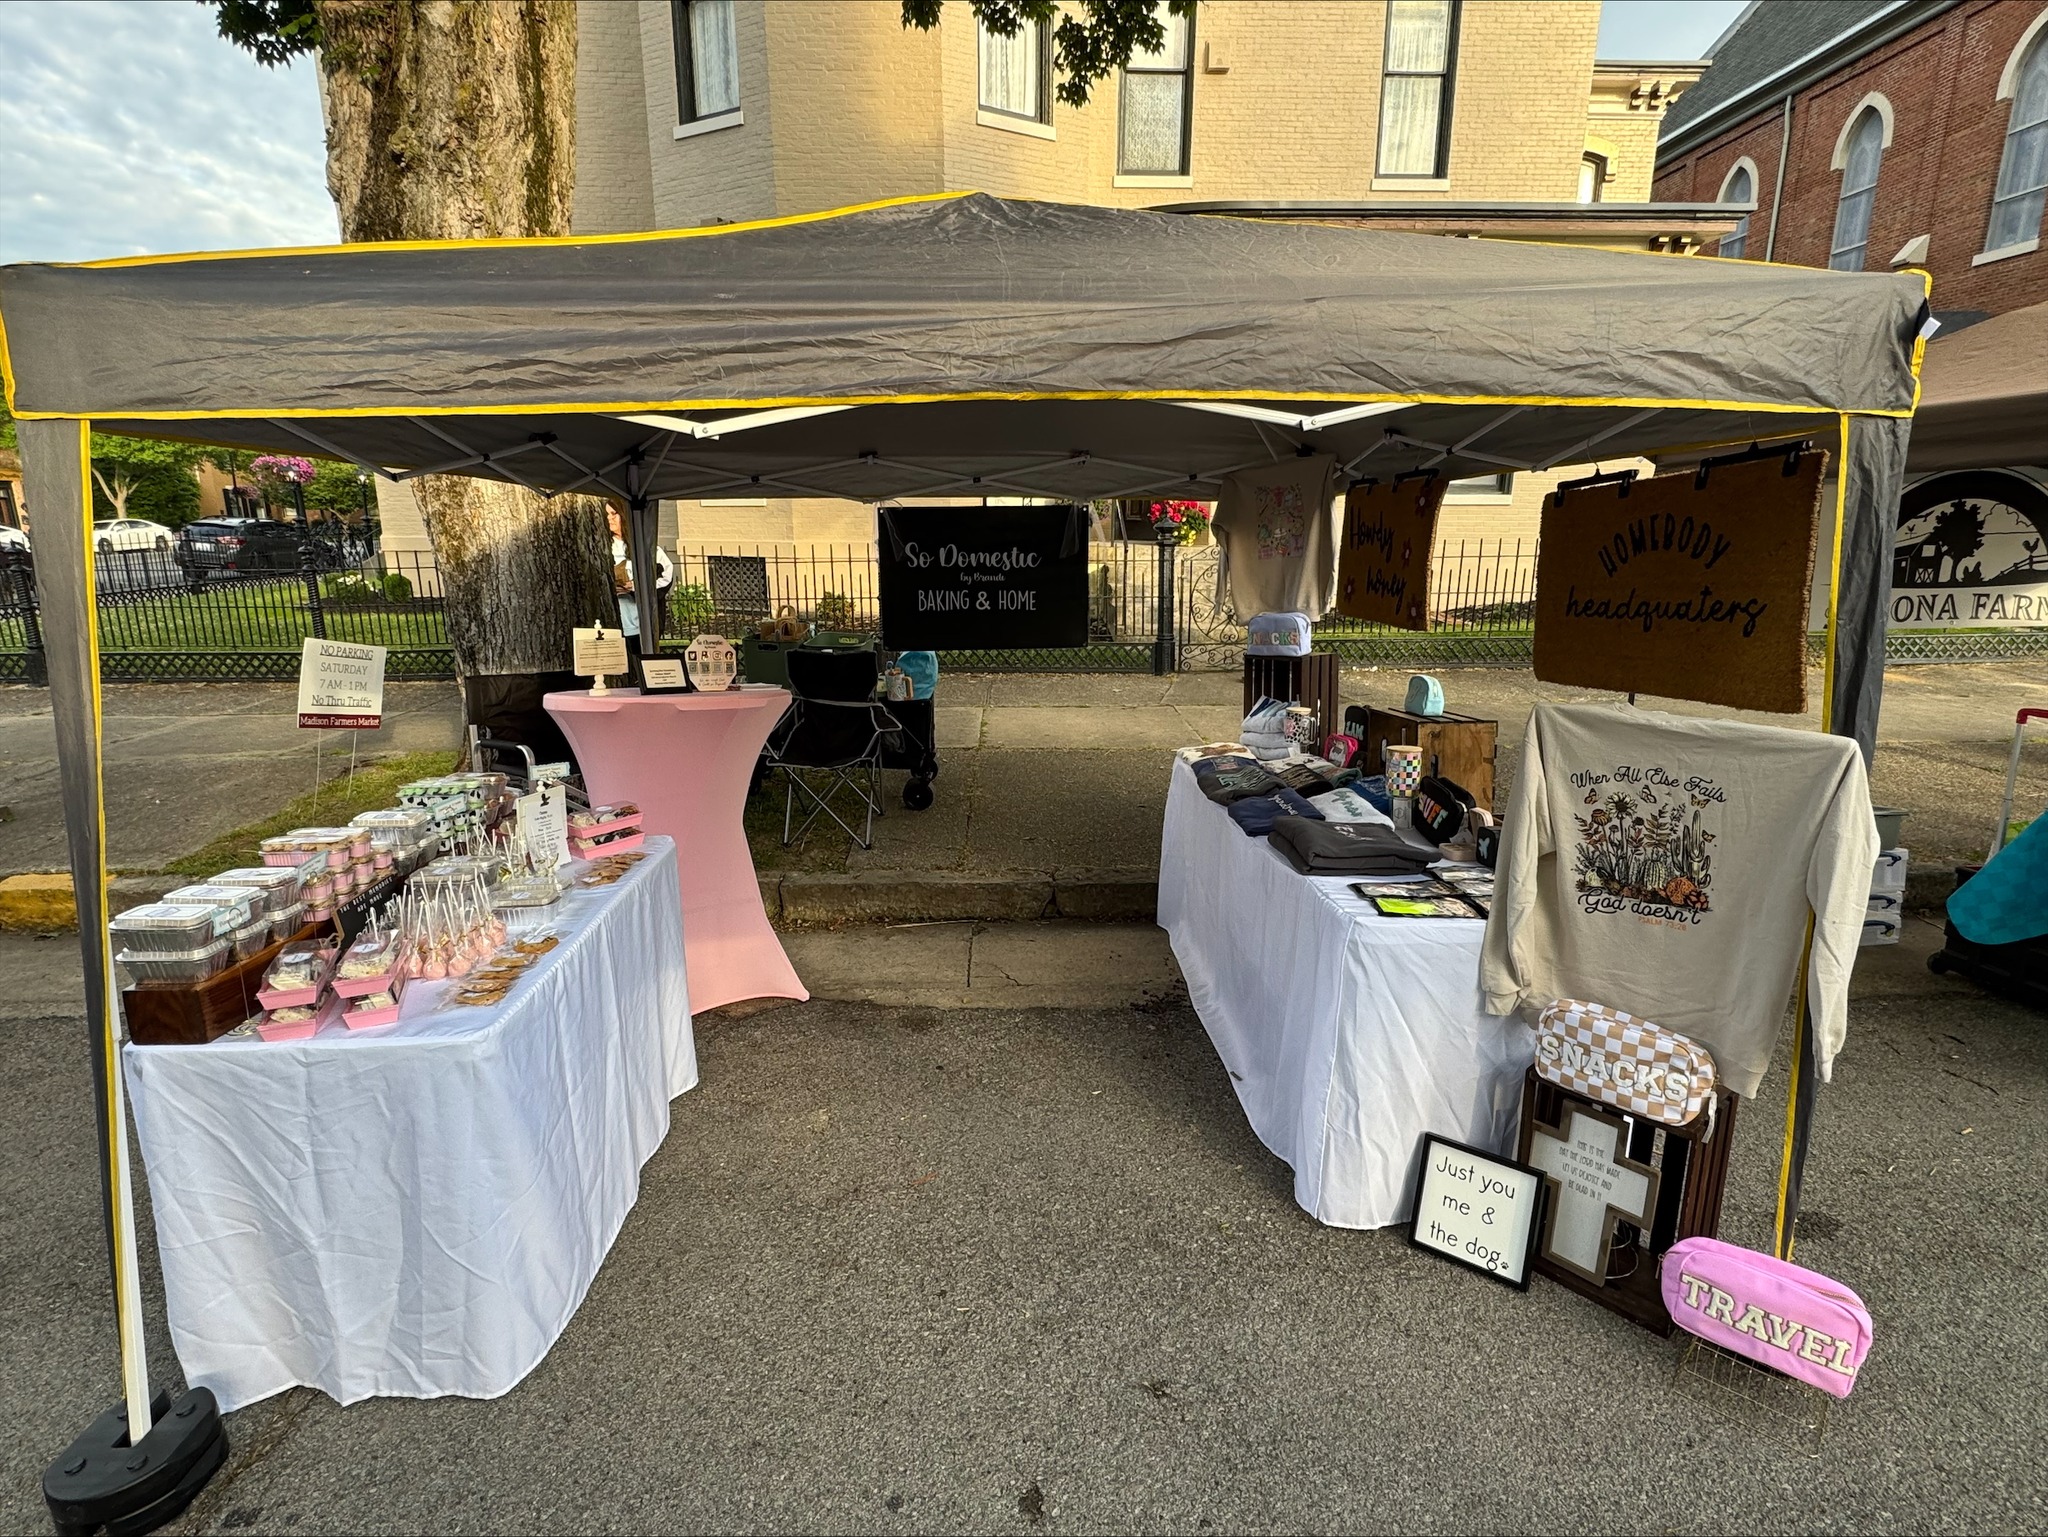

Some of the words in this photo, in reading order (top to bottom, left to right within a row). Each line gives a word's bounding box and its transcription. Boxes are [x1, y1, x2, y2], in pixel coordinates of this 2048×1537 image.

[1351, 504, 1395, 564] Howdy
[1598, 512, 1731, 578] HOMEBODY
[904, 541, 935, 568] So
[939, 543, 1043, 571] Domestic
[960, 572, 972, 585] by
[1366, 566, 1407, 615] honey
[918, 590, 970, 611] BAKING
[975, 591, 991, 610] &
[998, 590, 1037, 611] HOME
[1565, 585, 1768, 638] headquaters
[320, 645, 334, 656] NO
[336, 647, 373, 660] PARKING
[320, 662, 368, 675] SATURDAY
[320, 679, 326, 688] 7
[327, 680, 342, 689] AM
[354, 682, 367, 691] PM
[312, 695, 324, 706] No
[326, 696, 345, 706] Thru
[347, 696, 372, 708] Traffic
[300, 717, 329, 726] Madison
[330, 717, 357, 726] Farmers
[358, 718, 380, 726] Market
[1570, 769, 1610, 788] When
[1614, 766, 1642, 784] All
[1645, 768, 1679, 787] Else
[1684, 776, 1726, 803] Fails
[340, 904, 350, 914] THE
[352, 893, 366, 906] BEST
[357, 903, 367, 913] ARE
[369, 893, 382, 905] MADE
[1578, 888, 1626, 914] God
[1631, 900, 1701, 925] doesn't
[1638, 916, 1663, 926] PSALM
[1541, 1033, 1691, 1103] SNACKS
[1436, 1156, 1475, 1183] Just
[1478, 1175, 1515, 1200] you
[1442, 1195, 1470, 1216] me
[1481, 1206, 1495, 1225] &
[1430, 1220, 1458, 1247] the
[1465, 1237, 1501, 1272] dog
[1681, 1272, 1856, 1377] TRAVEL
